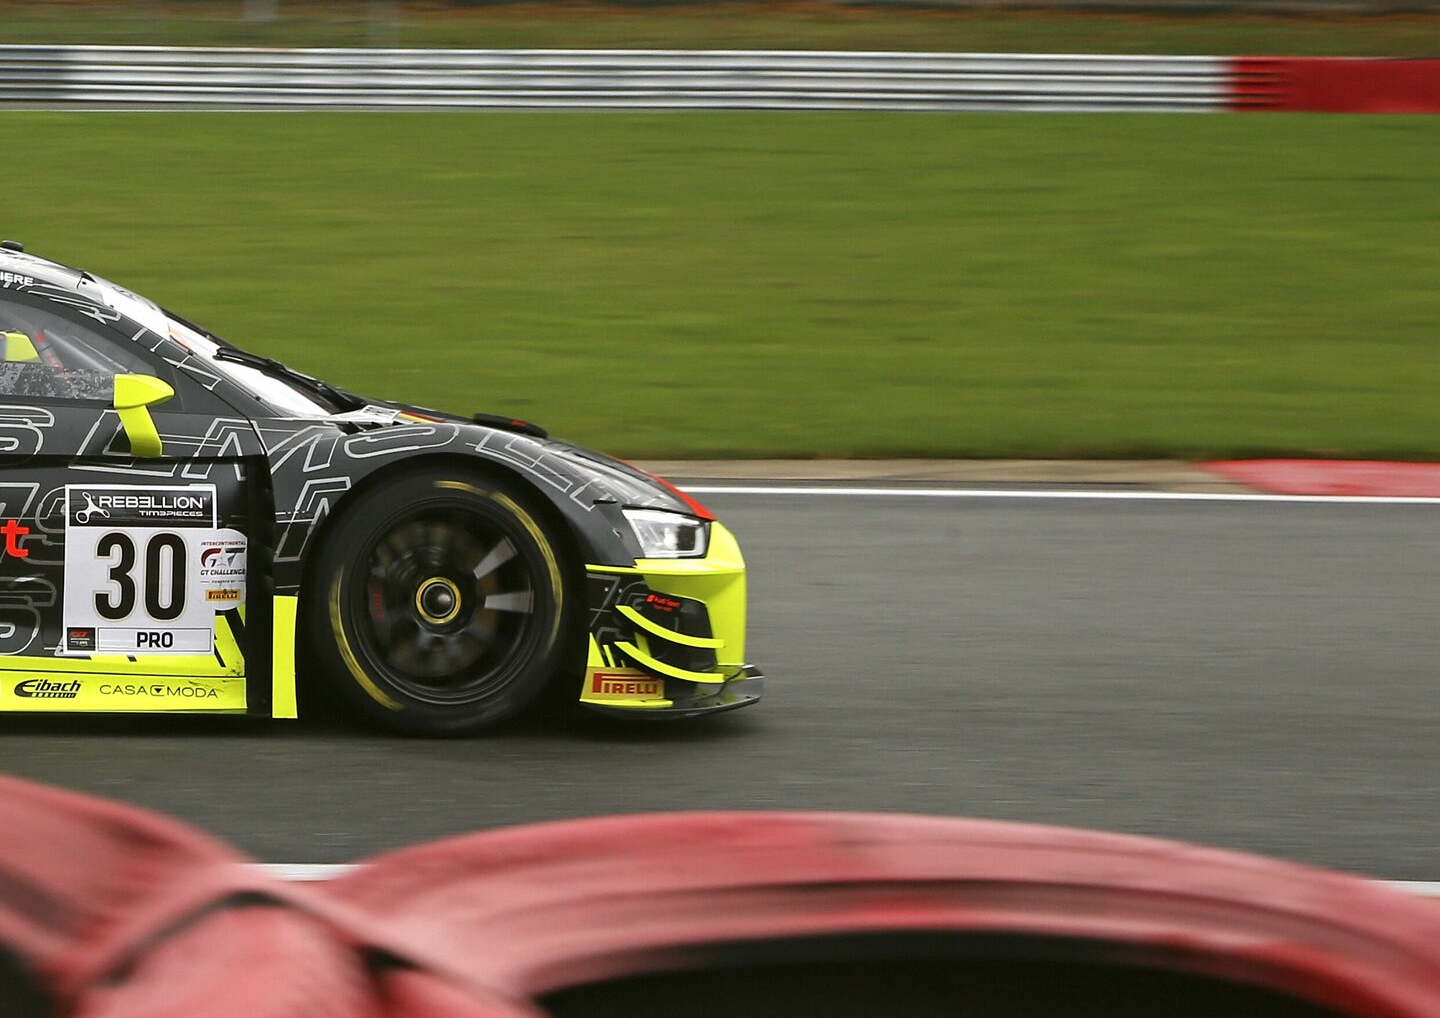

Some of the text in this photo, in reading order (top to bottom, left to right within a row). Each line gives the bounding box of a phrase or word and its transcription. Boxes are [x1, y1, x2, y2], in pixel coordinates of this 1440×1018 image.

[95, 531, 188, 621] 30
[136, 632, 174, 648] PRO
[13, 679, 82, 698] Eibach
[99, 684, 219, 699] CASA MODA
[592, 672, 659, 695] PIRELLI
